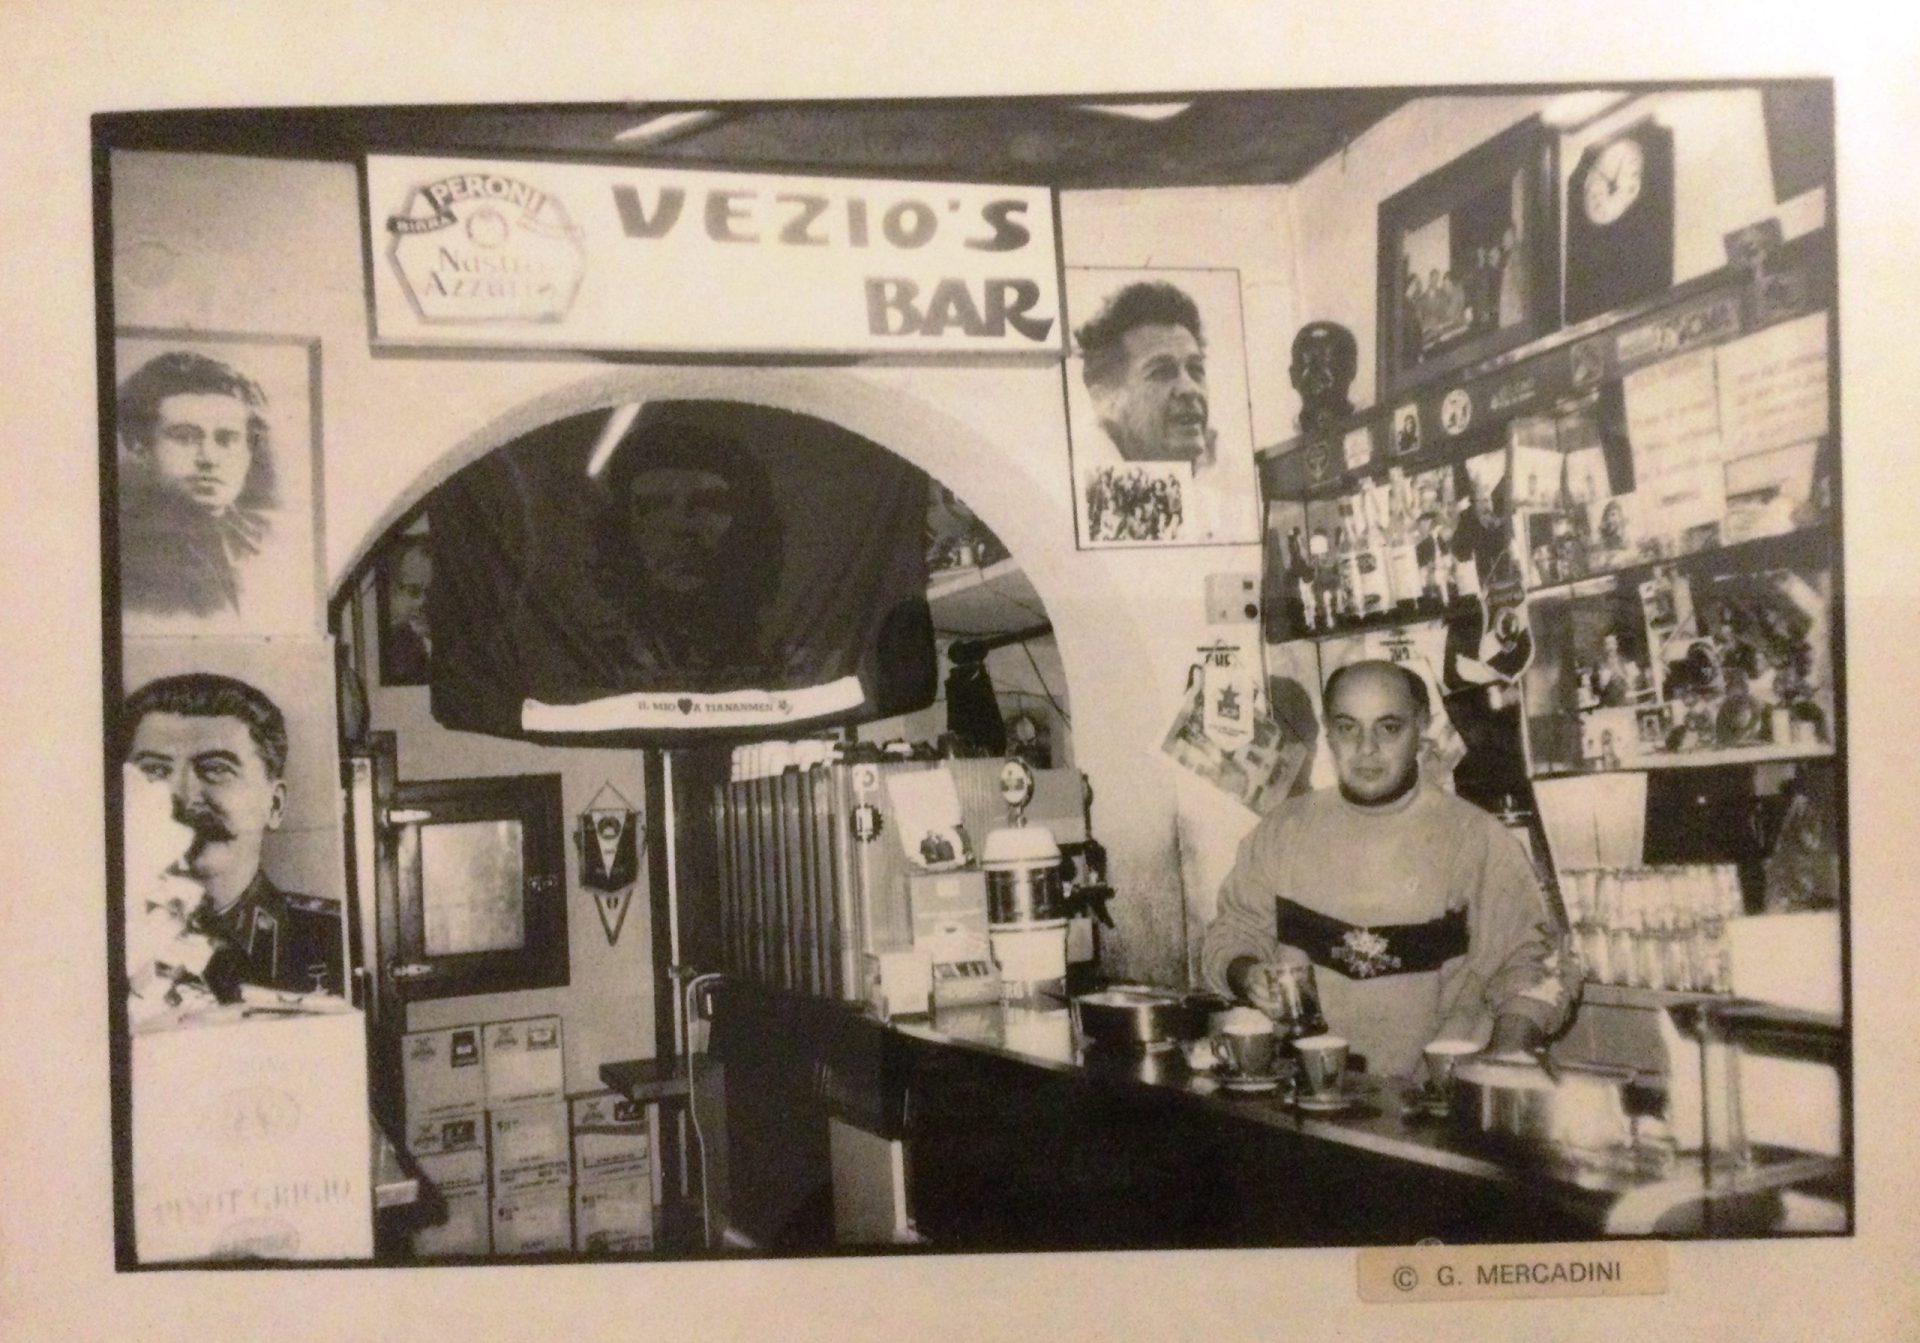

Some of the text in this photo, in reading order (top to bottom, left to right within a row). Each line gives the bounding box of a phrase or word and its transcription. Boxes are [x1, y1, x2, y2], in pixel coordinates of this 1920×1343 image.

[430, 175, 543, 218] PERONI
[396, 215, 451, 233] BIRRA
[611, 184, 1031, 252] VEZIO'S
[864, 276, 1054, 342] BAR
[652, 702, 677, 712] MIO
[693, 703, 702, 713] A
[1437, 1266, 1462, 1287] G.
[1477, 1261, 1621, 1285] MERCADINI
